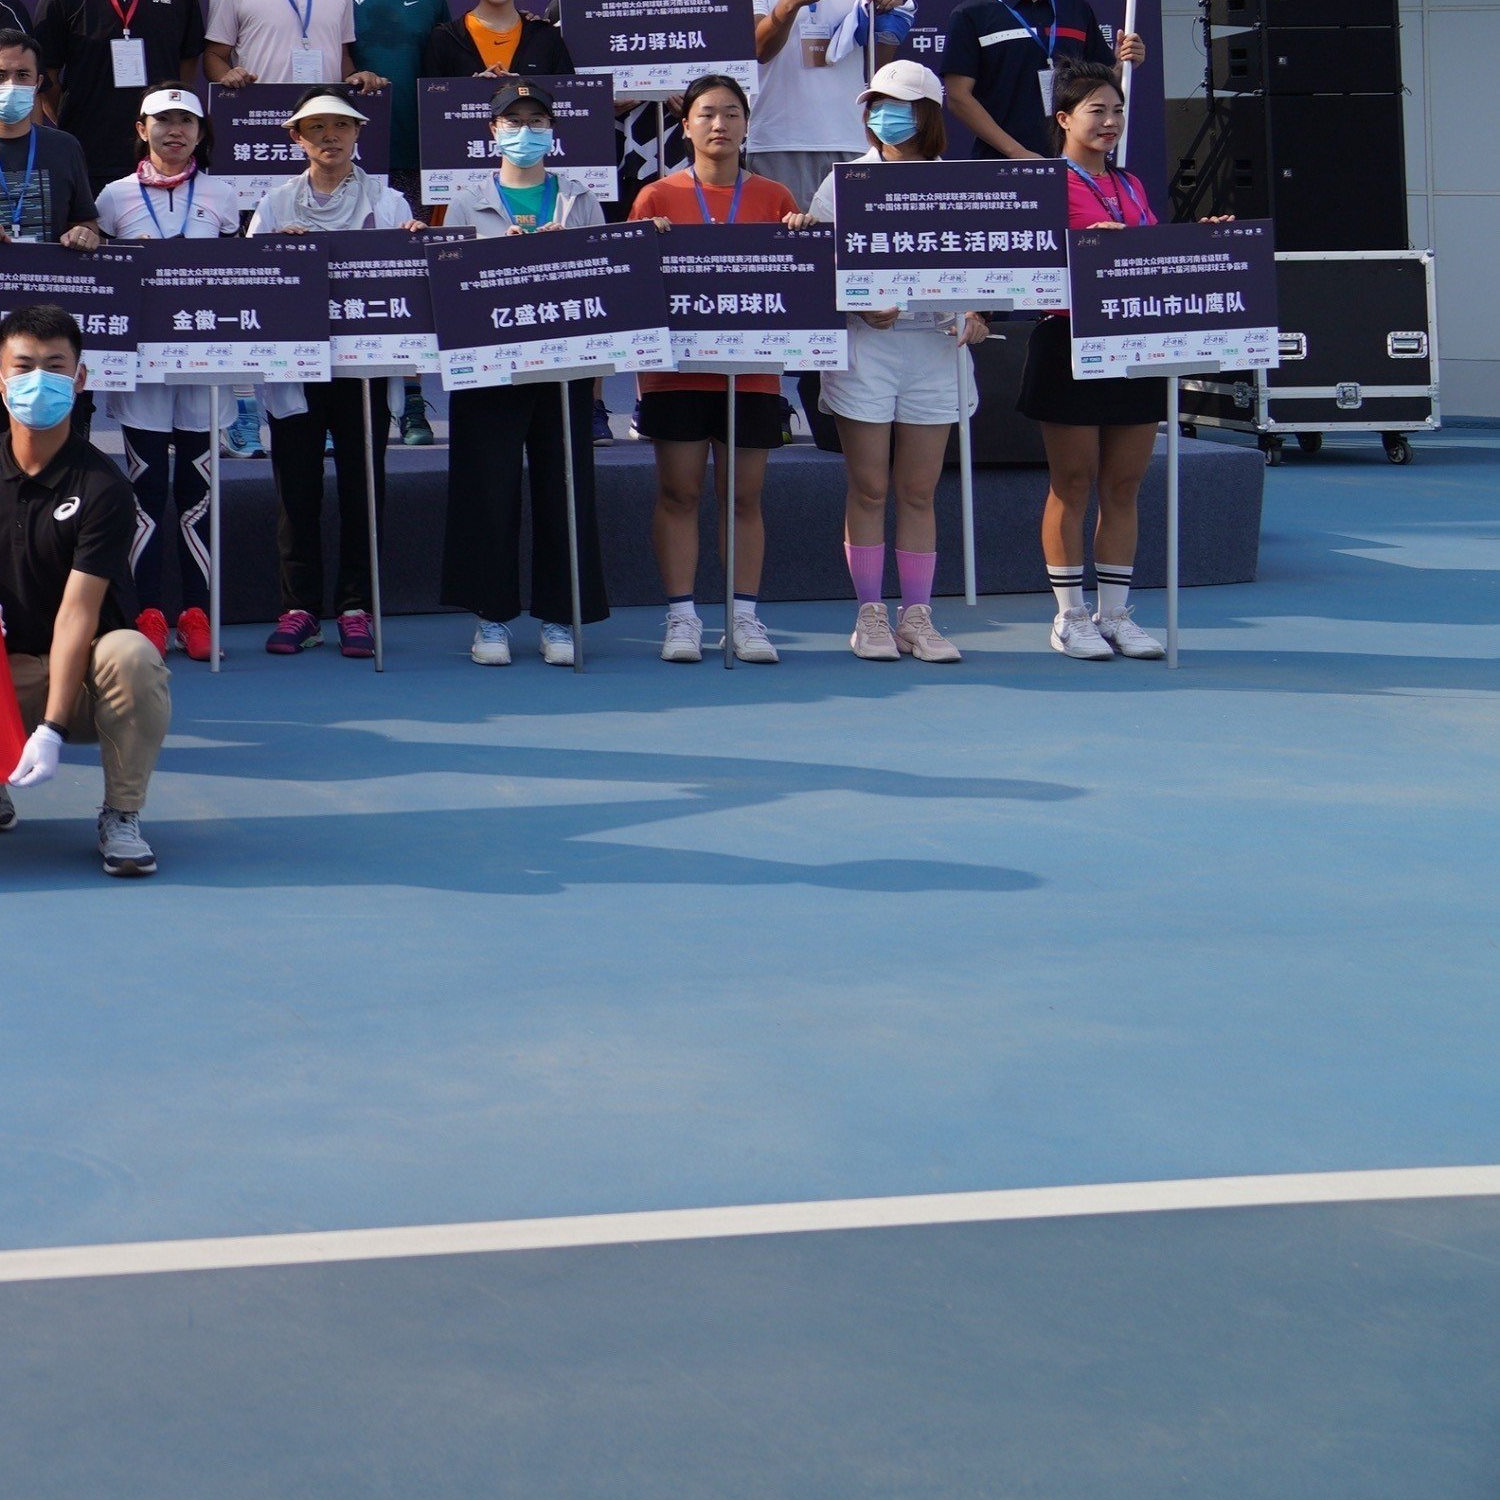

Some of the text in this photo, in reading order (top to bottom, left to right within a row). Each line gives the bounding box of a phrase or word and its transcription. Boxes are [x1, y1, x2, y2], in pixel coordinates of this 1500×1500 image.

[609, 31, 707, 52] 活力驿站队
[885, 191, 1017, 201] 首届中国大众网球联赛河南省级联赛
[845, 230, 1058, 254] 许昌快乐生活网球队
[328, 259, 429, 270] 大众网球联赛河南省级联赛
[660, 263, 816, 274] 国体育彩票杯”第六届河南网球球王争霸赛
[141, 276, 300, 287] “中国体育彩票杯”第六届河南网球球王争霸赛
[490, 297, 607, 329] 亿盛体育队
[669, 293, 787, 315] 开心网球队
[1100, 291, 1246, 319] 平顶山市山鹰队
[172, 309, 261, 331] 金徽一队
